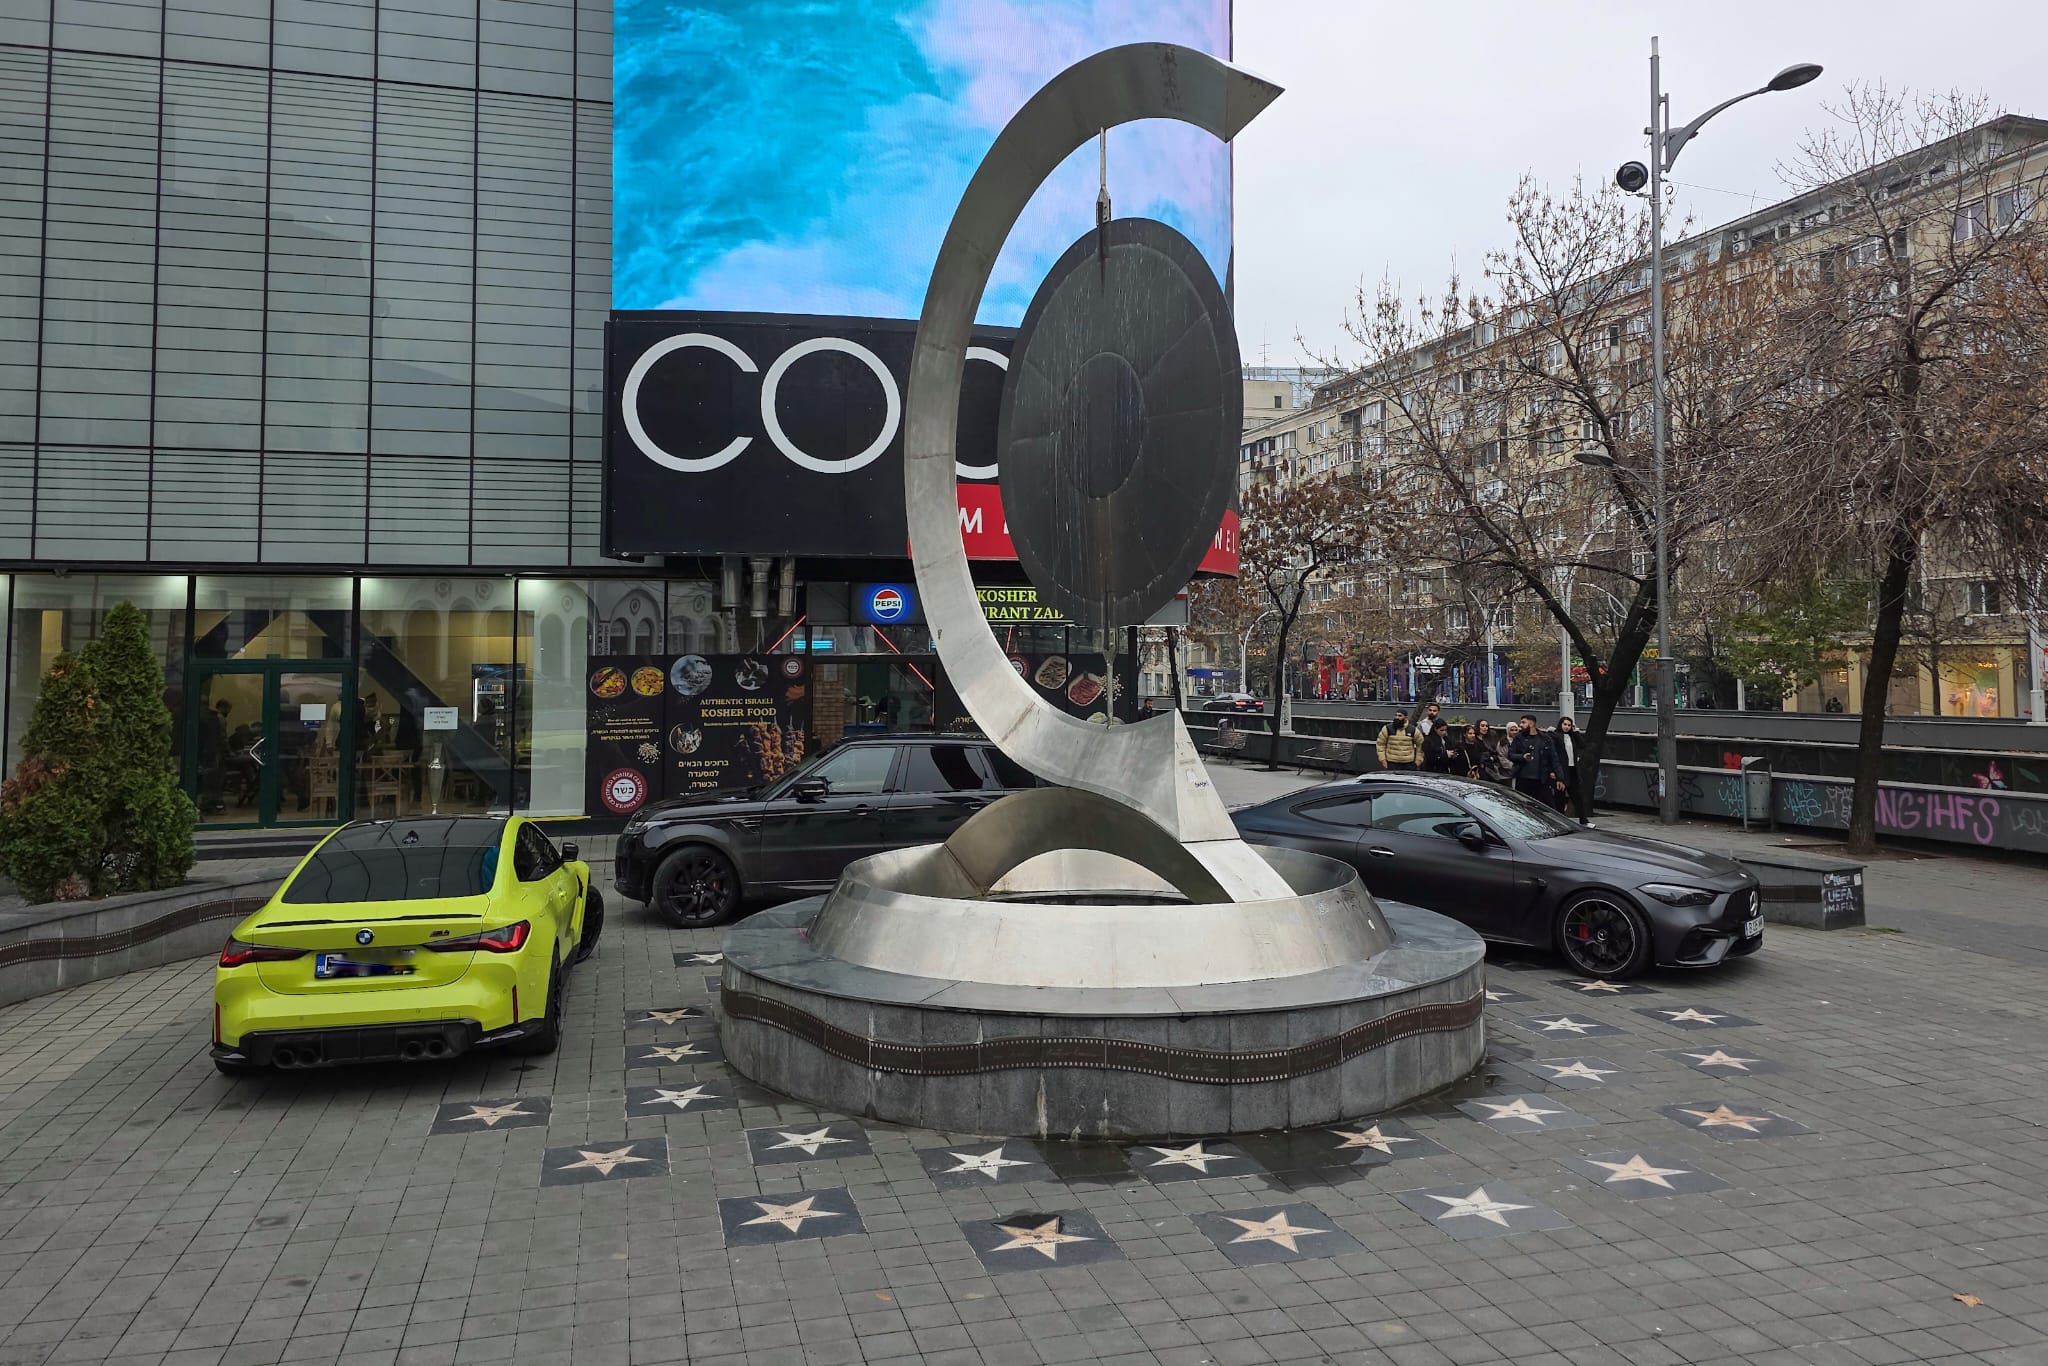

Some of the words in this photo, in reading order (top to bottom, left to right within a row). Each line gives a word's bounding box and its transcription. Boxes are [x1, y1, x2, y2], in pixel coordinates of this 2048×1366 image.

[977, 589, 1038, 603] KOSHER
[700, 698, 744, 706] AUTHENTIC
[745, 697, 773, 705] ISRAELI
[701, 708, 745, 718] KOSHER
[747, 707, 777, 717] FOOD
[678, 760, 703, 768] הבאים
[1827, 887, 1855, 902] UEFA
